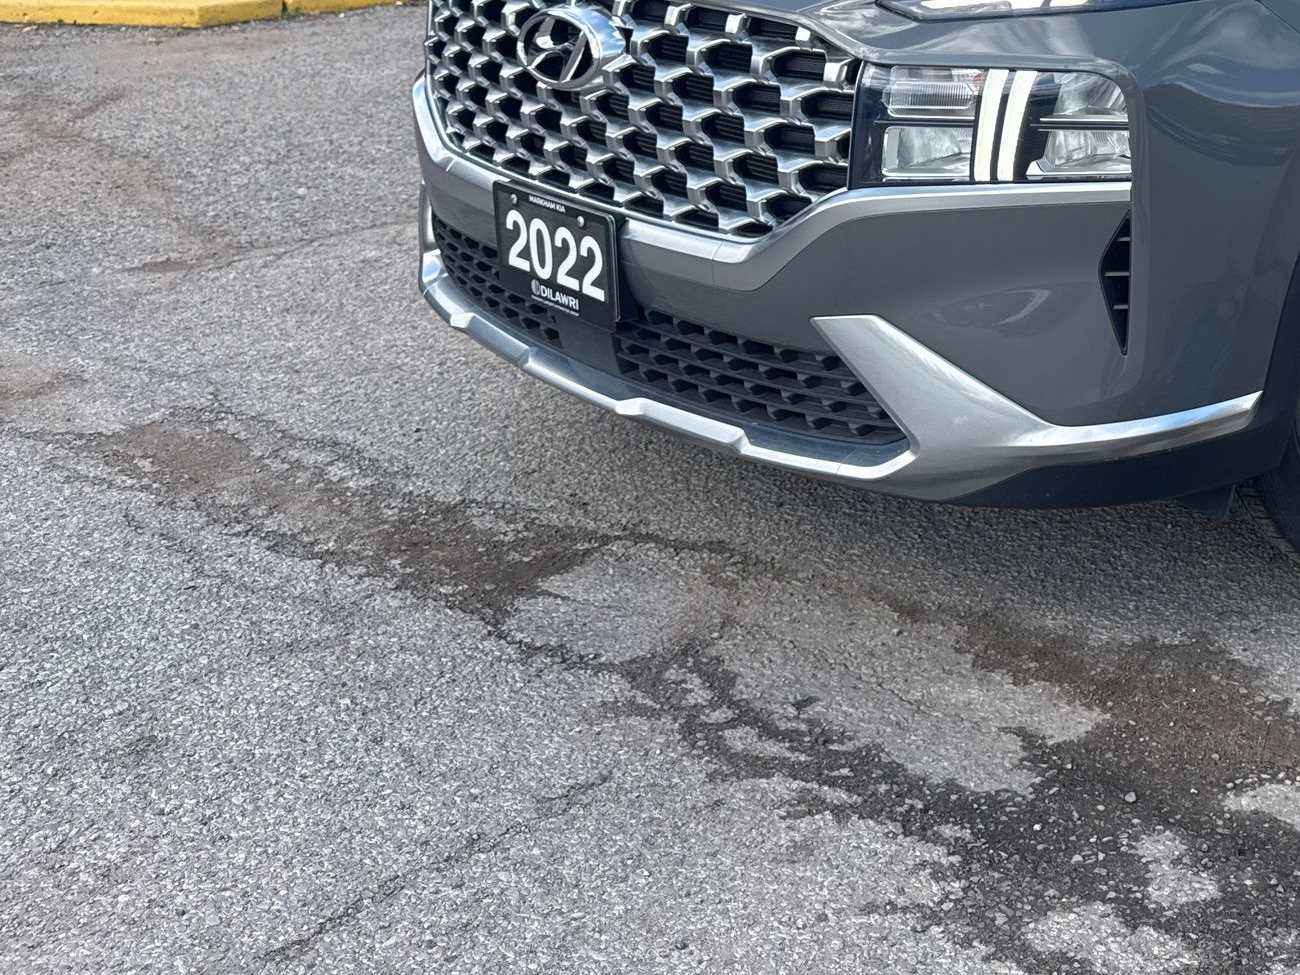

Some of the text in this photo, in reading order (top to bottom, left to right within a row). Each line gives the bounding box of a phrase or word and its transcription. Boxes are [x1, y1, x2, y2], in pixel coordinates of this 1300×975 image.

[528, 194, 567, 214] MARKHAM KIA
[506, 209, 605, 302] 2022
[540, 284, 580, 311] DILAWRI
